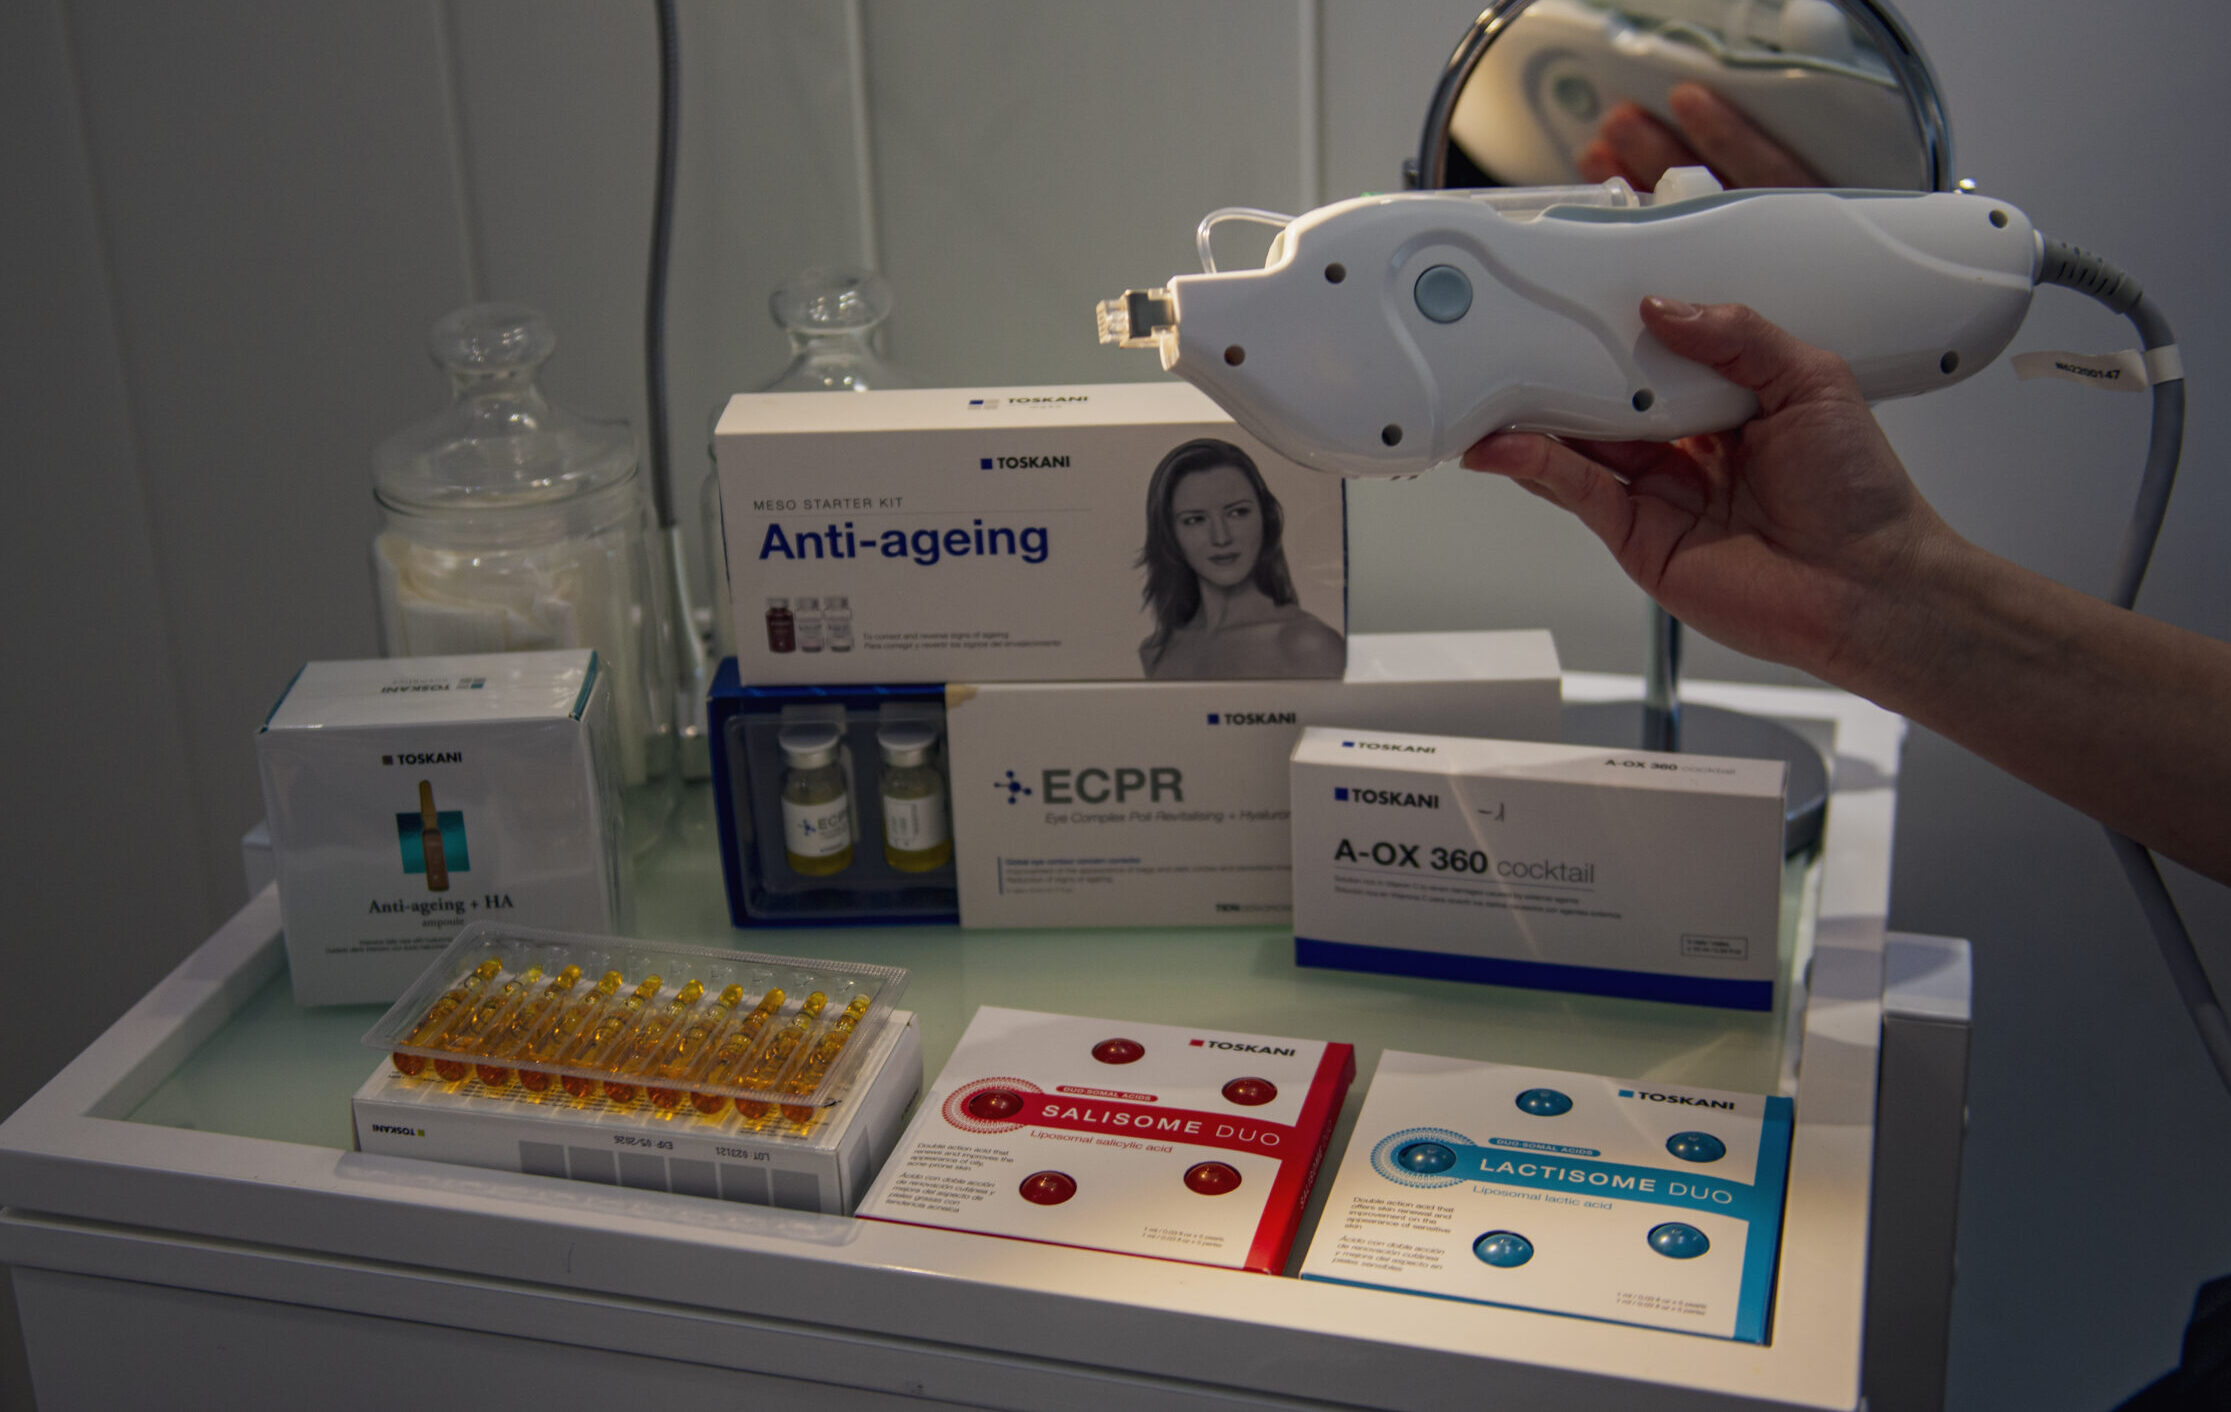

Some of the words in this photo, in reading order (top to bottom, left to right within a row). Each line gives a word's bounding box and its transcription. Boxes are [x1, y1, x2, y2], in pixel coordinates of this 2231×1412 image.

[1009, 396, 1088, 404] TOSKANI
[997, 456, 1071, 469] TOSKANI
[753, 499, 797, 511] MESO
[803, 498, 873, 510] STARTER
[879, 497, 903, 508] KIT
[759, 518, 1049, 566] Anti-ageing
[1224, 712, 1297, 725] TOSKANI
[1359, 742, 1437, 754] TOSKANI
[397, 752, 462, 765] TOSKANI
[1605, 759, 1646, 768] A-OX
[1041, 768, 1184, 803] ECPR
[1352, 788, 1440, 809] TOSKANI
[1044, 812, 1068, 825] Eye
[1071, 811, 1125, 824] Complex
[1334, 838, 1421, 869] A-OX
[1430, 847, 1489, 875] 360
[1497, 859, 1595, 884] cocktail
[368, 897, 466, 916] Anti-ageing
[470, 900, 479, 909] +
[484, 894, 514, 909] HA
[1208, 1040, 1297, 1056] TOSKANI
[1122, 1093, 1151, 1101] ACIDS
[1638, 1091, 1735, 1110] TOSKANI
[372, 1124, 416, 1136] TOSKANI
[1042, 1104, 1203, 1134] SALISOME
[1215, 1124, 1280, 1146] DUO
[1030, 1129, 1095, 1145] Liposomal
[1096, 1134, 1143, 1151] salicylic
[1146, 1143, 1173, 1153] acid
[962, 1152, 998, 1162] improves
[993, 1148, 1009, 1156] that
[1561, 1147, 1594, 1156] ACIDS
[910, 1156, 957, 1164] appearance
[1480, 1158, 1656, 1192] LACTISOME
[1668, 1182, 1733, 1205] DUO
[1353, 1197, 1385, 1205] Double
[1387, 1200, 1414, 1208] action
[1473, 1185, 1542, 1202] Liposomal
[1544, 1193, 1580, 1206] lactic
[1583, 1200, 1613, 1210] acid
[1398, 1209, 1432, 1217] renewal
[1434, 1212, 1452, 1220] and
[1422, 1217, 1437, 1225] the
